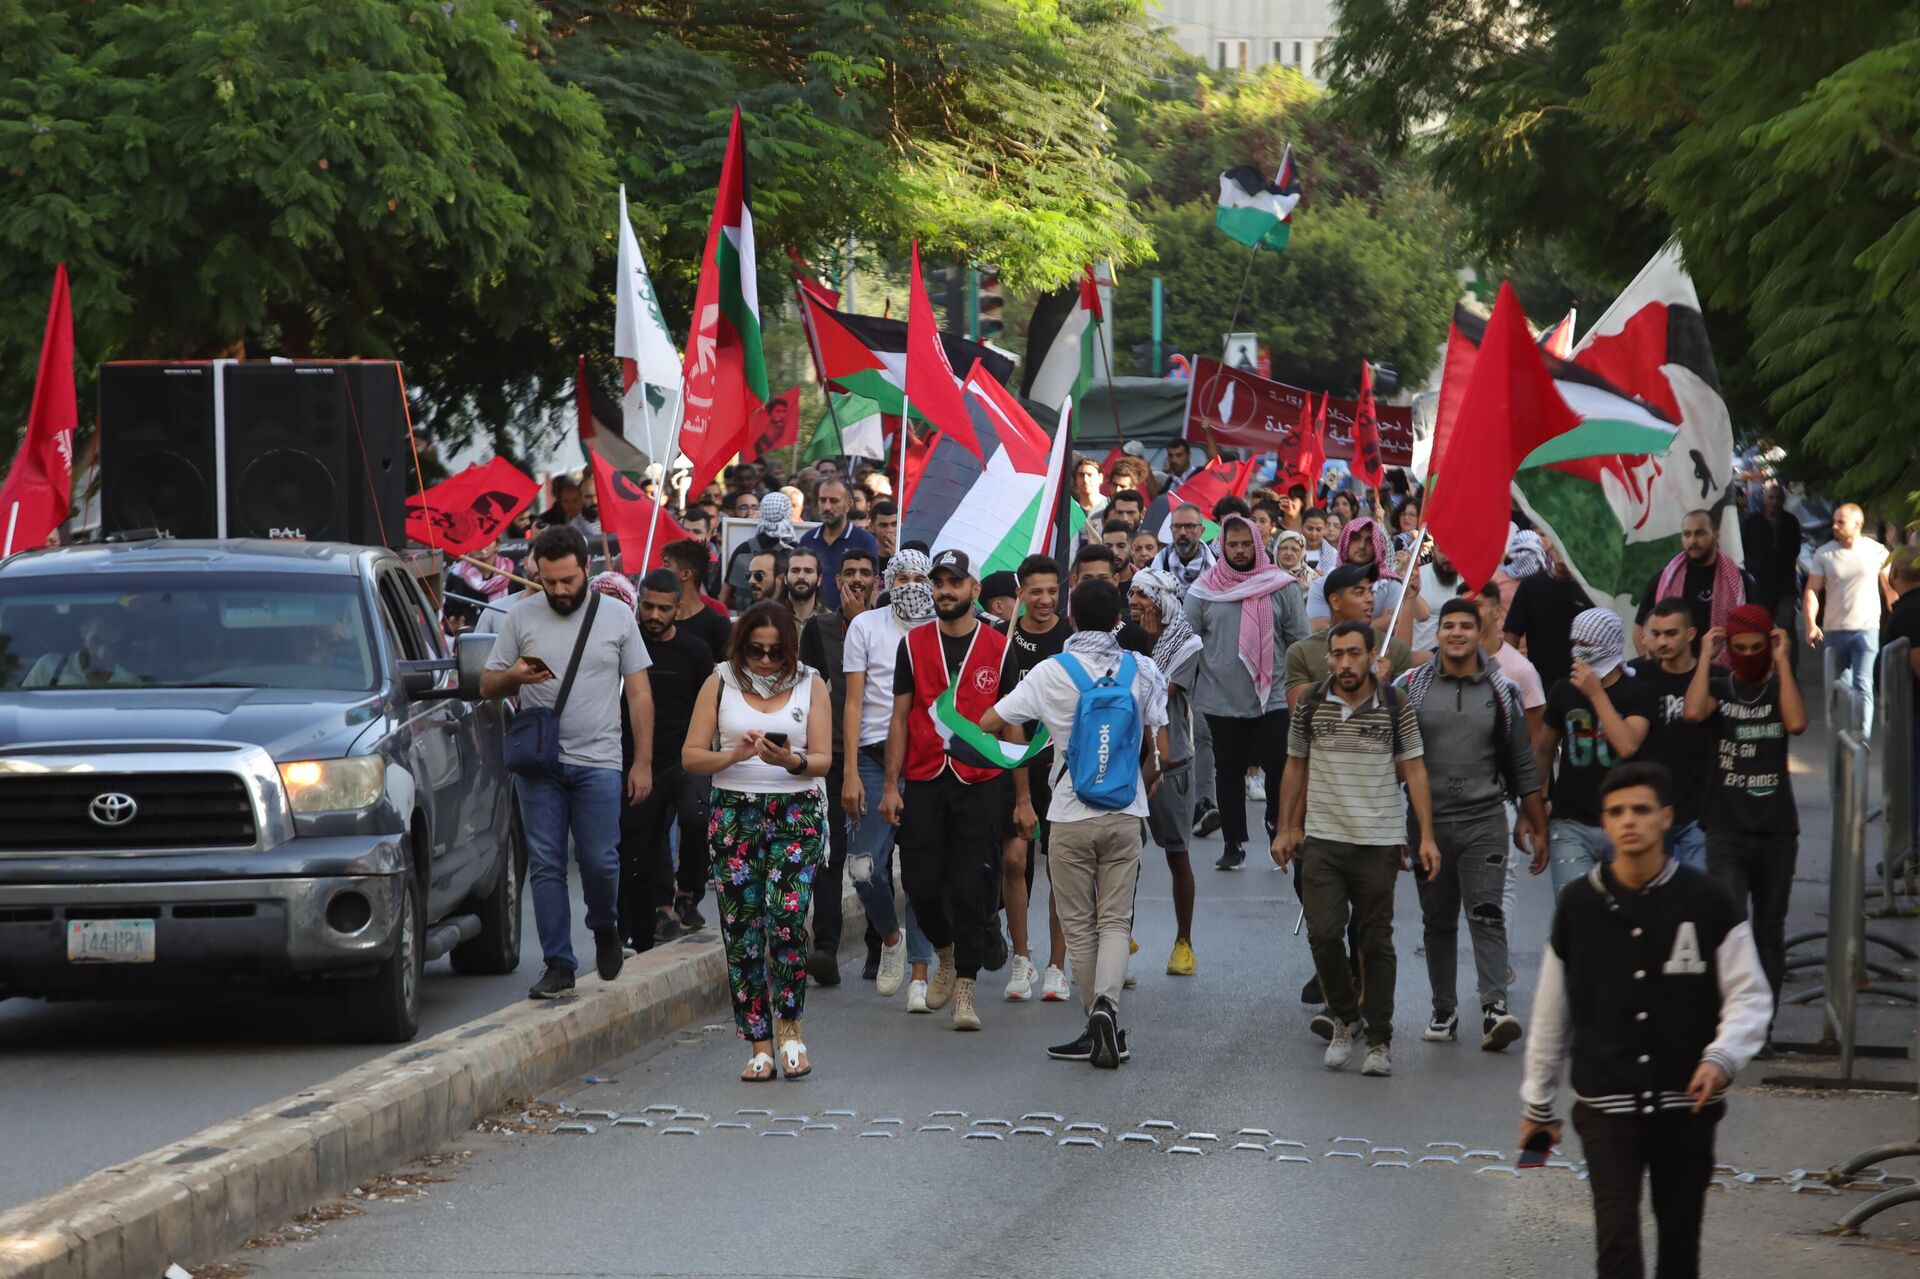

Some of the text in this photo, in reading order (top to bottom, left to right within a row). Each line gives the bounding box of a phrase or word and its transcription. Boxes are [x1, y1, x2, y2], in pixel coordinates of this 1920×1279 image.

[268, 527, 306, 539] PAL
[1013, 627, 1038, 652] ERSACE
[1095, 724, 1110, 784] Reebok
[1747, 773, 1779, 787] RIDES
[1662, 921, 1707, 974] A
